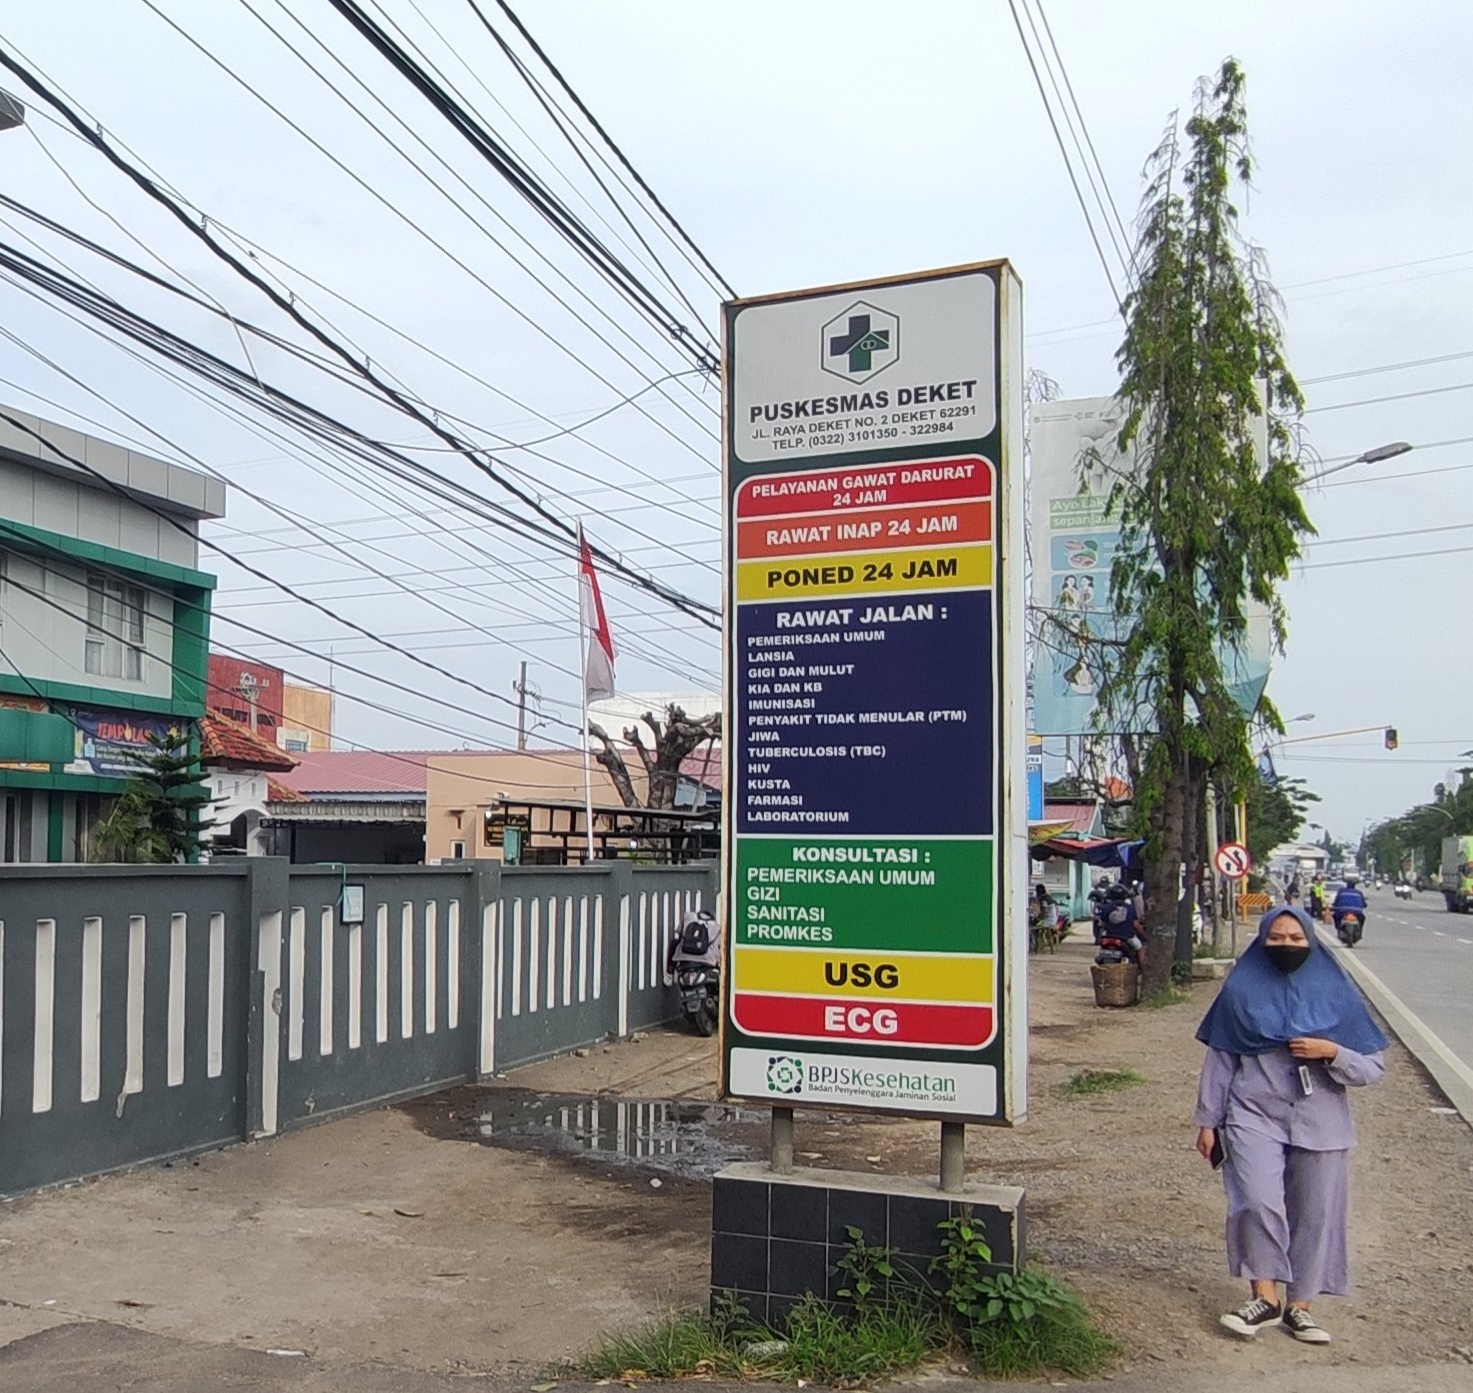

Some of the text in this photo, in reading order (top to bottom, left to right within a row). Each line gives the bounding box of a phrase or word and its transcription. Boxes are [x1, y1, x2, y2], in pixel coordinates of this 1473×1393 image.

[750, 380, 978, 424] PUSKESMAS DEKET
[752, 405, 977, 440] JL. RAYA DEKET NO. 2 DEKET 62291
[772, 436, 806, 450] TELP.
[808, 432, 845, 449] (0322)
[848, 427, 898, 443] 3101350
[909, 421, 954, 437] 322984
[752, 465, 975, 498] PELAYANAN GAWAT DARURAT
[832, 490, 887, 507] 24 JAM
[1053, 500, 1078, 512] Ayo
[766, 515, 958, 546] RAWAT INAP 24 JAM
[767, 558, 958, 588] PONED 24 JAM
[776, 608, 853, 628] RAWAT
[859, 604, 933, 624] JALAN
[747, 630, 885, 647] PEMERIKSAAN UMUM
[748, 651, 795, 663] LANSIA
[748, 664, 854, 678] GIGI DAN MULUT
[748, 682, 822, 694] KIA DAN KB
[748, 698, 815, 710] IMUNISASI
[748, 710, 967, 726] PENYAKIT TIDAK MENULAR (PTM)
[748, 731, 780, 742] JIWA
[748, 745, 886, 758] TUBERCULOSIS (TBC)
[748, 764, 771, 774] HIV
[747, 779, 791, 790] KUSTA
[747, 795, 803, 806] FARMASI
[747, 811, 849, 822] LABORATORIUM
[792, 847, 918, 863] KONSULTASI
[747, 868, 935, 885] PEMERIKSAAN UMUM
[747, 886, 780, 901] GIZI
[747, 905, 825, 922] SANITASI
[747, 924, 833, 941] PROMKES
[824, 962, 899, 989] USG
[824, 1005, 898, 1035] ECG
[808, 1083, 956, 1102] Badan Penyelenggara Jaminan Sosial
